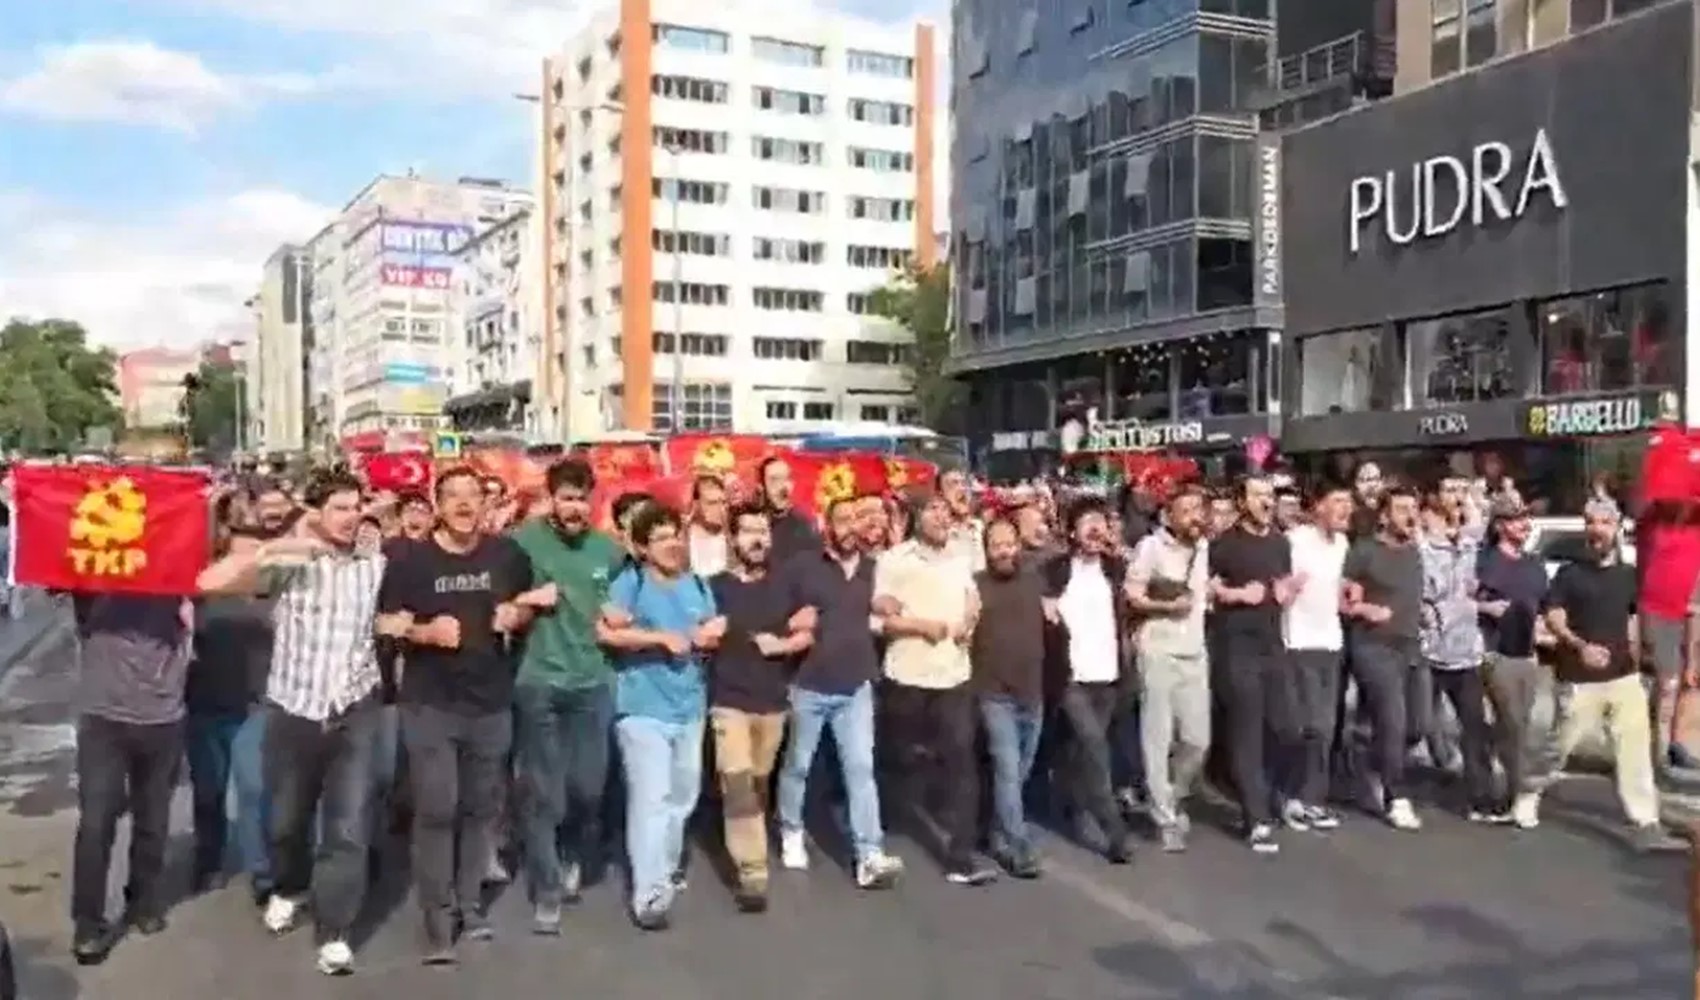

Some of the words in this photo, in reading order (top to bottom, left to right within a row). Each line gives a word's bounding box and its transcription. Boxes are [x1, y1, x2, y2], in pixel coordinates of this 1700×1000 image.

[1349, 127, 1568, 252] PUDRA
[1419, 413, 1468, 435] PUDRA
[67, 548, 148, 577] TKP
